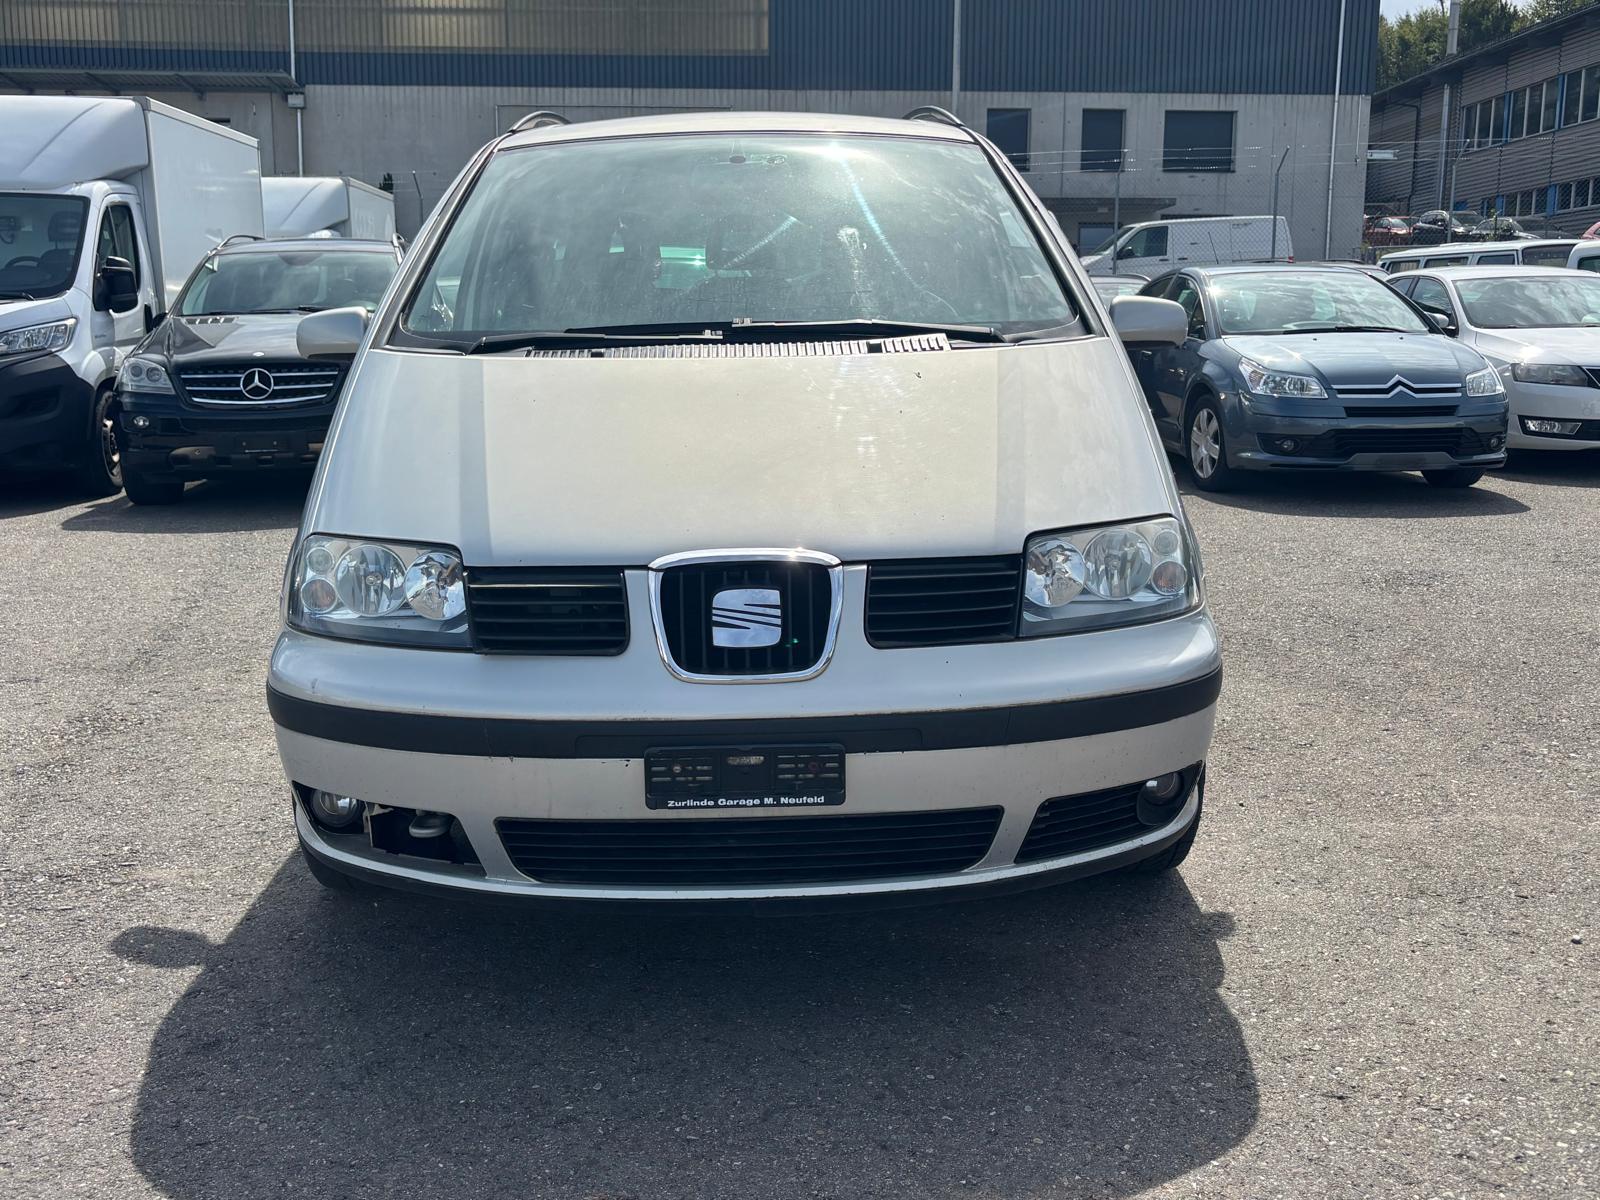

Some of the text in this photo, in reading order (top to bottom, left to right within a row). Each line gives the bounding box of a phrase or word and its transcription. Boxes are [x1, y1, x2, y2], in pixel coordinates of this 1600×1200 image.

[667, 795, 825, 807] Zurlinde Garage M. Neufeld
